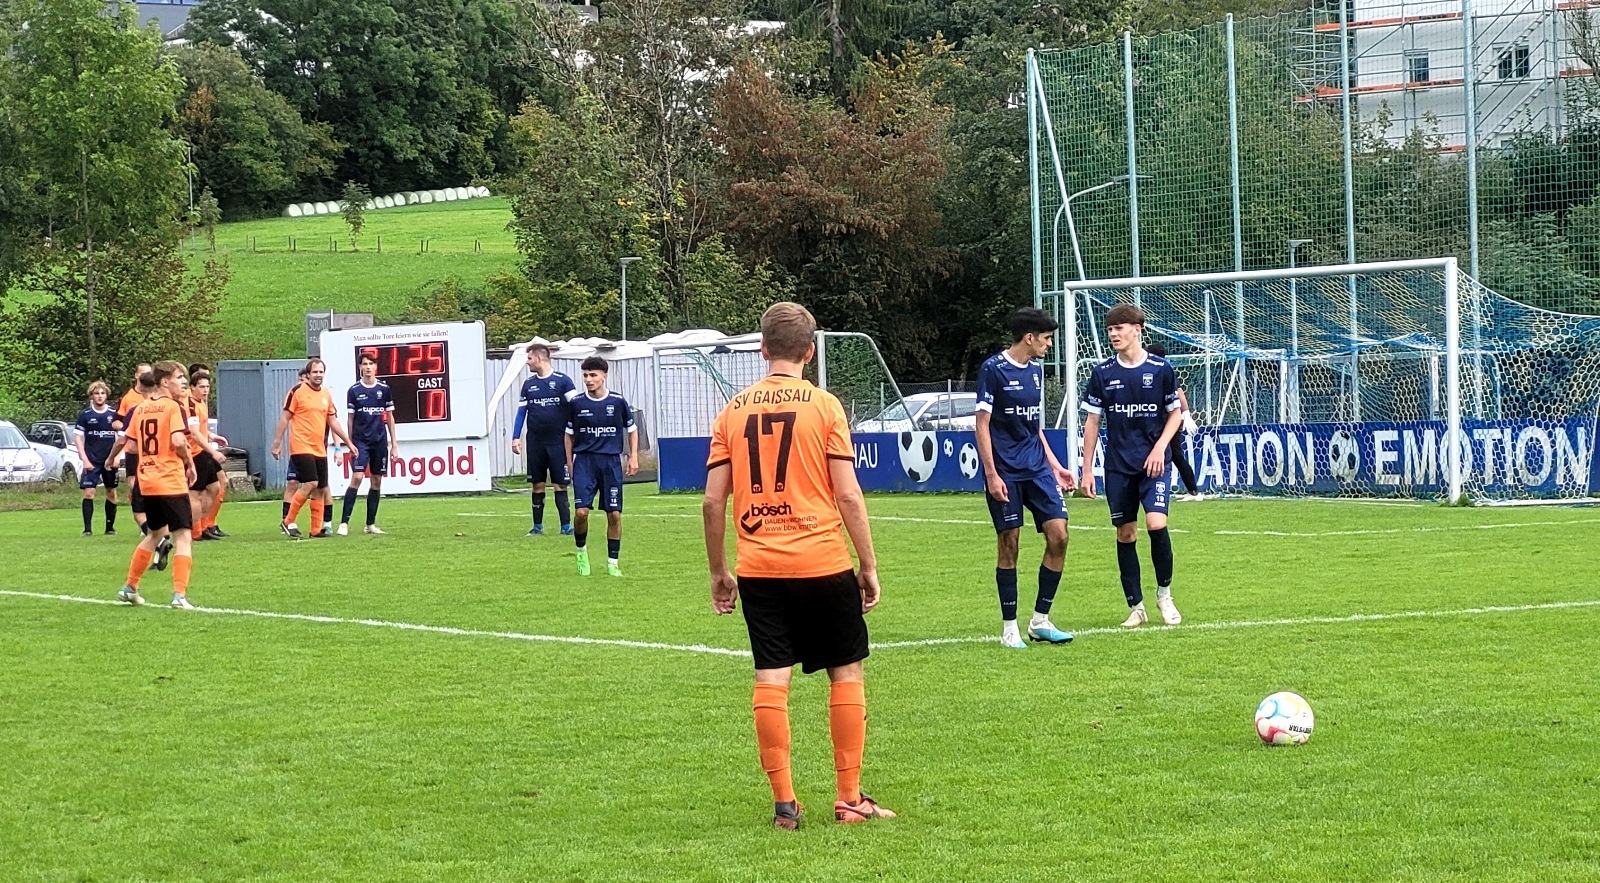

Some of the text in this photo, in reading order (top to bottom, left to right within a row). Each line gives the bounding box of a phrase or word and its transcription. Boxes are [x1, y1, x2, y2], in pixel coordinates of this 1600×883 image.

[309, 319, 329, 331] SOUND
[395, 331, 412, 339] feiern
[431, 329, 449, 337] fallen!
[417, 377, 443, 389] GAST
[430, 390, 445, 419] 0
[533, 396, 561, 407] typico
[734, 389, 812, 410] SV GAISSAU
[1115, 402, 1158, 418] typico
[140, 418, 159, 457] 18
[587, 426, 617, 438] typico
[743, 411, 797, 494] 17
[1373, 427, 1588, 487] EMOTION
[342, 445, 475, 486] Mngold
[751, 501, 793, 517] bösch
